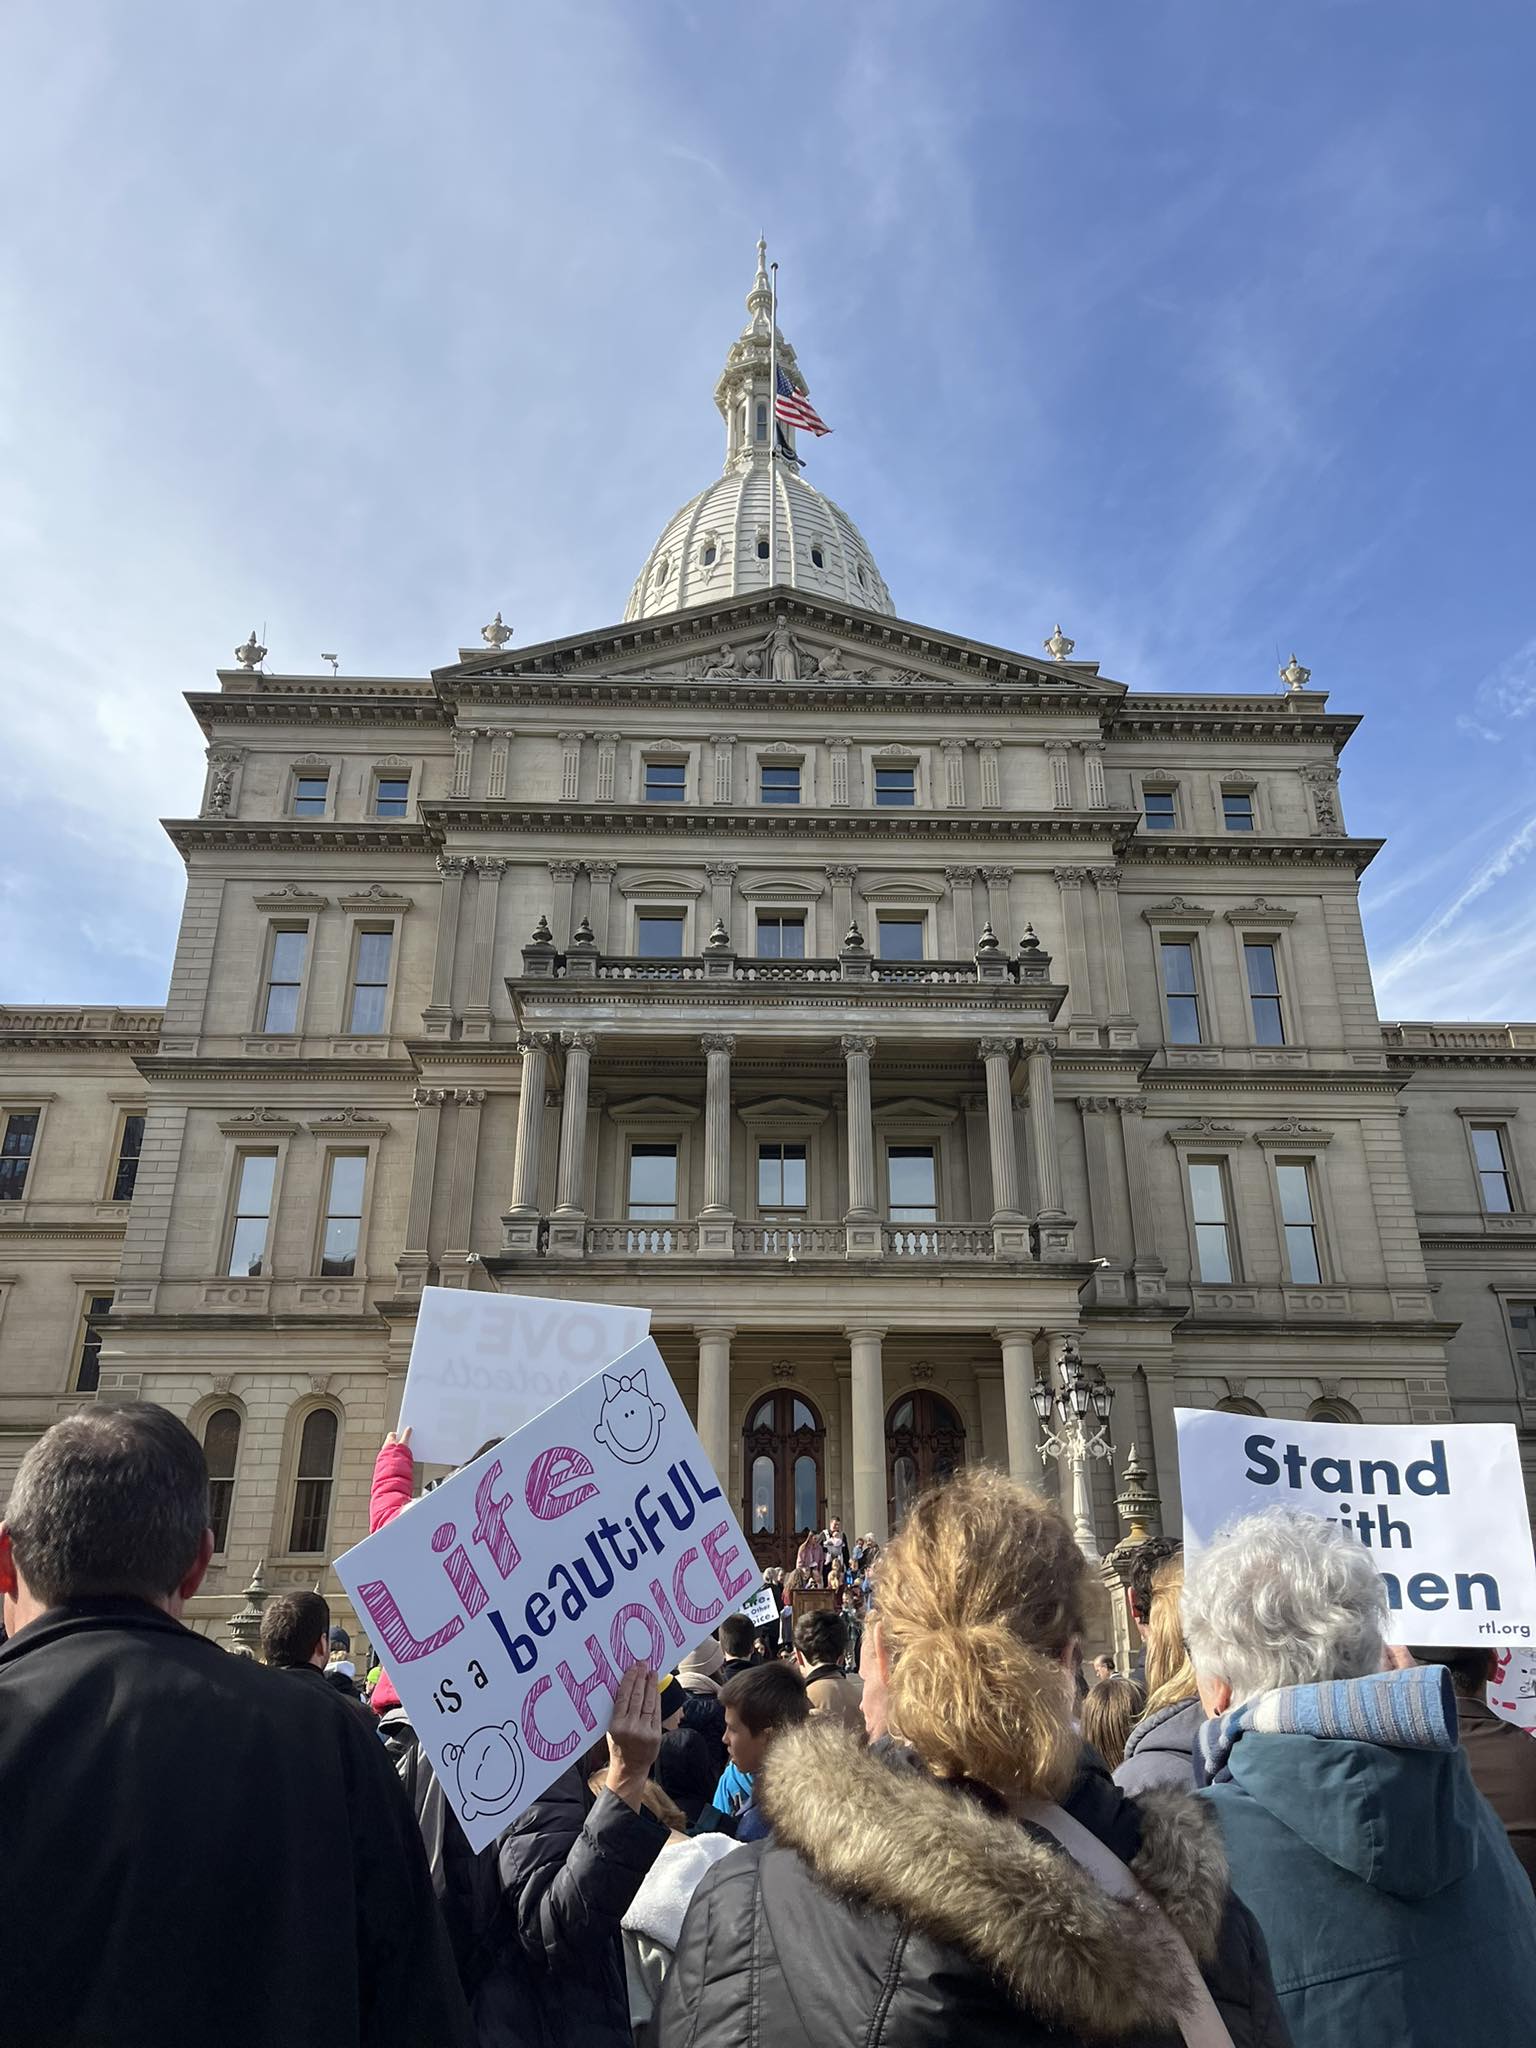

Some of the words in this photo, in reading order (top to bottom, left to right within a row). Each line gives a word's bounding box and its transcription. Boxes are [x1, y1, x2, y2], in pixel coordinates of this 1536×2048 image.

[1244, 1434, 1450, 1496] Stand
[1326, 1503, 1413, 1549] ith
[357, 1446, 600, 1664] Life
[520, 1520, 752, 1762] CHOICE
[1478, 1620, 1531, 1638] rtl.org
[467, 1660, 489, 1690] a
